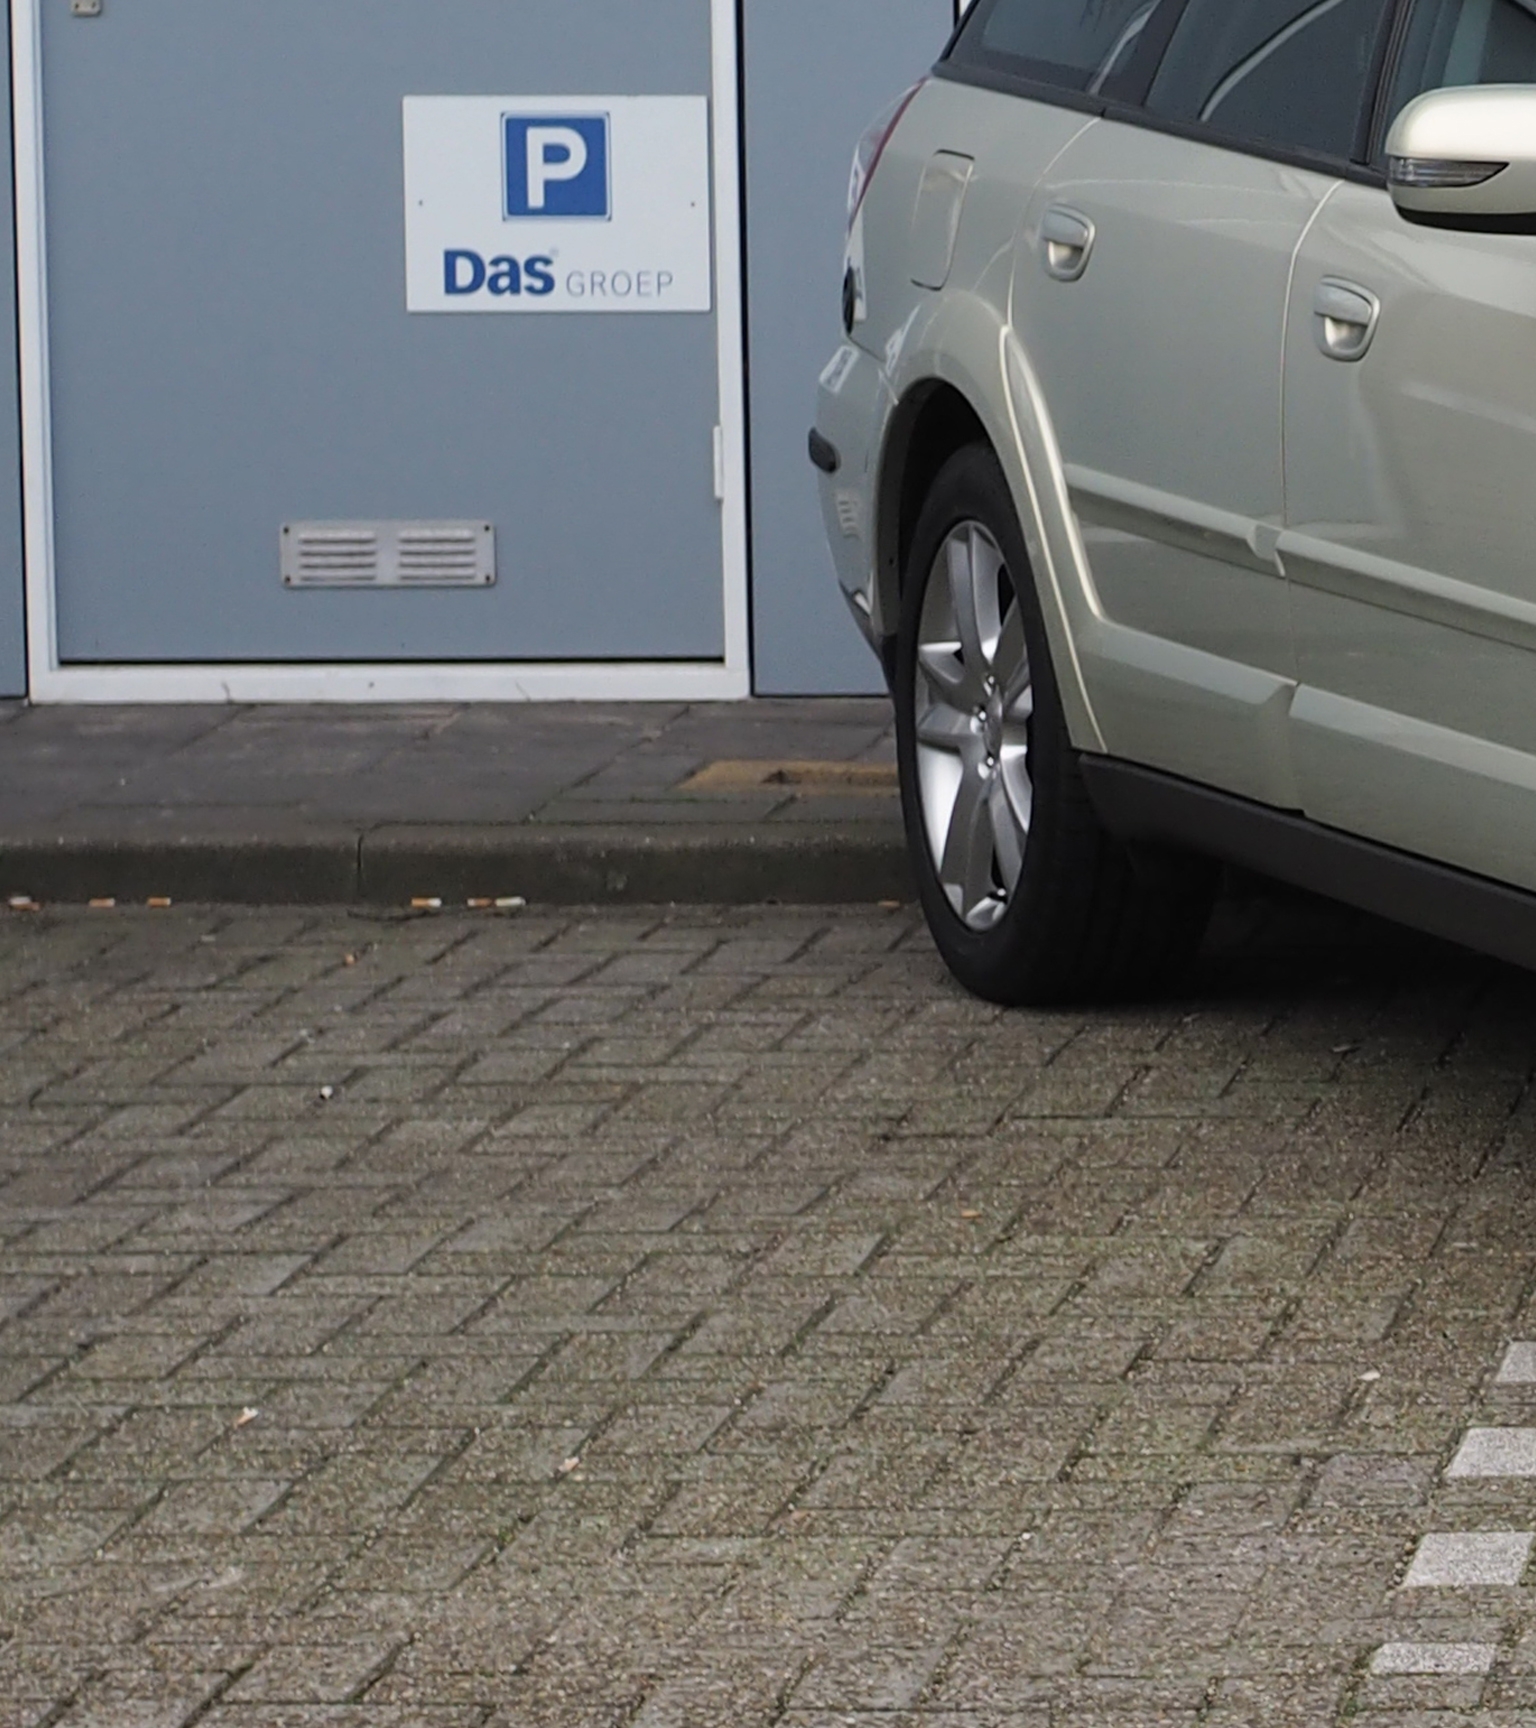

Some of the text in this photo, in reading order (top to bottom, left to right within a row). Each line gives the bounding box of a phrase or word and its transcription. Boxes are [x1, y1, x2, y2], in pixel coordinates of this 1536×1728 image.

[526, 125, 588, 210] P
[443, 249, 674, 298] Das GROEP
